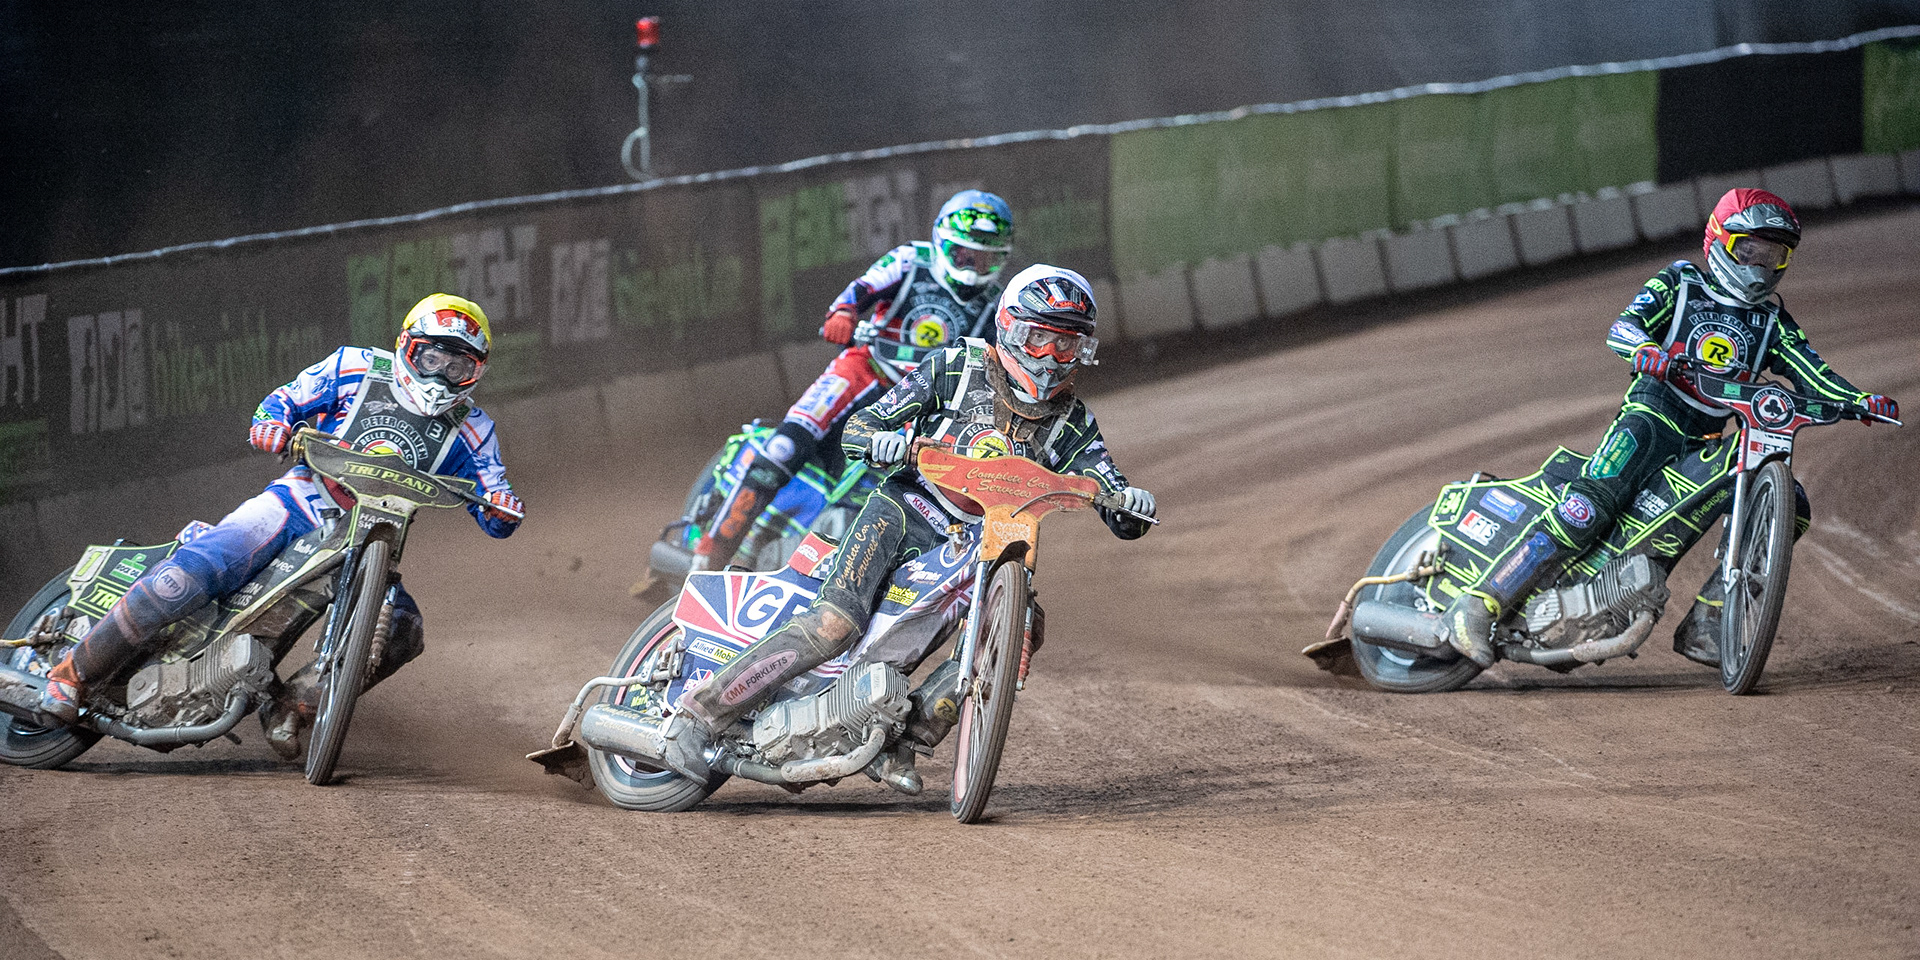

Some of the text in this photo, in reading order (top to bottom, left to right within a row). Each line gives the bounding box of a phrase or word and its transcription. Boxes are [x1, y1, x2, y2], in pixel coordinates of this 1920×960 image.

[360, 431, 385, 446] BELLE
[390, 434, 406, 448] VUE
[361, 415, 428, 460] PETER CRAVEN
[429, 422, 443, 437] 3
[349, 464, 434, 494] TRU PLANT
[966, 467, 1023, 484] Complete
[977, 480, 1032, 498] Services
[912, 497, 930, 518] KMA
[835, 543, 861, 589] Complete
[850, 535, 879, 587] Services
[693, 641, 738, 664] Allied Mobi
[724, 656, 788, 701] KMA FORKLIFTS
